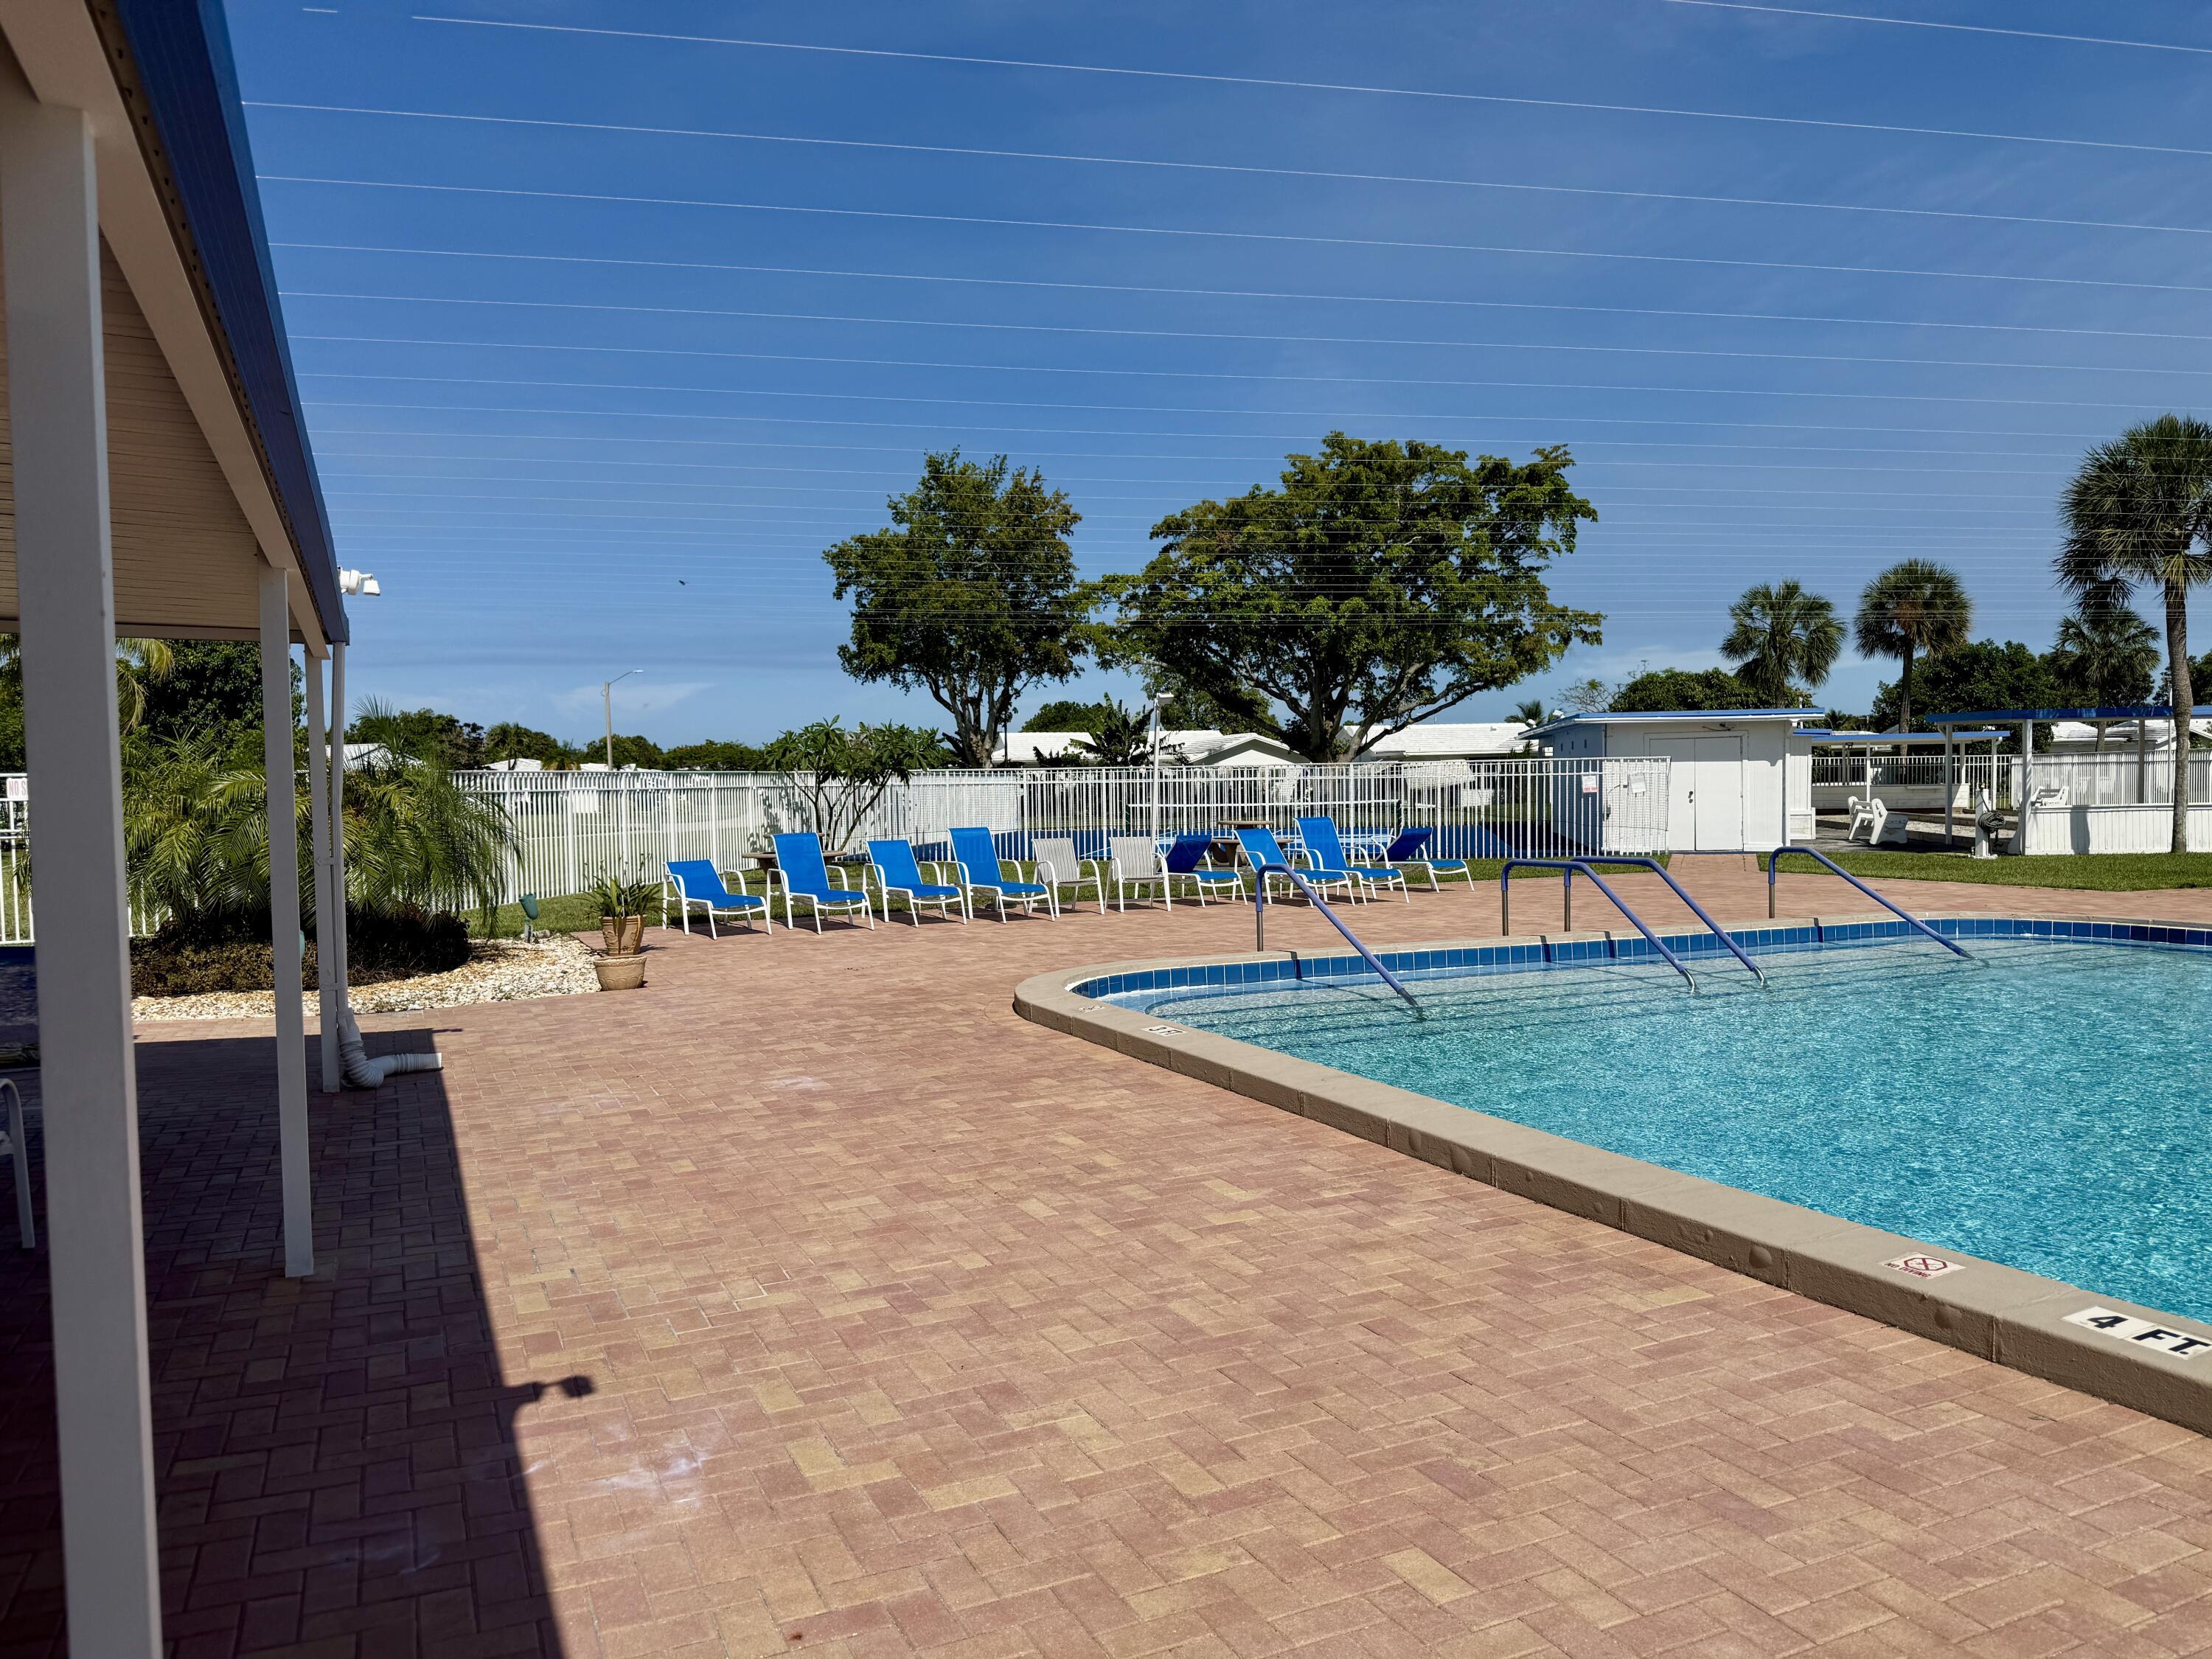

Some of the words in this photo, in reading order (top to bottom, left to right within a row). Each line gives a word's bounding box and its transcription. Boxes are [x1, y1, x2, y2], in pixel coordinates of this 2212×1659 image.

[9, 780, 19, 796] NO
[1899, 1267, 1931, 1278] DIVING
[2087, 1315, 2129, 1329] 4
